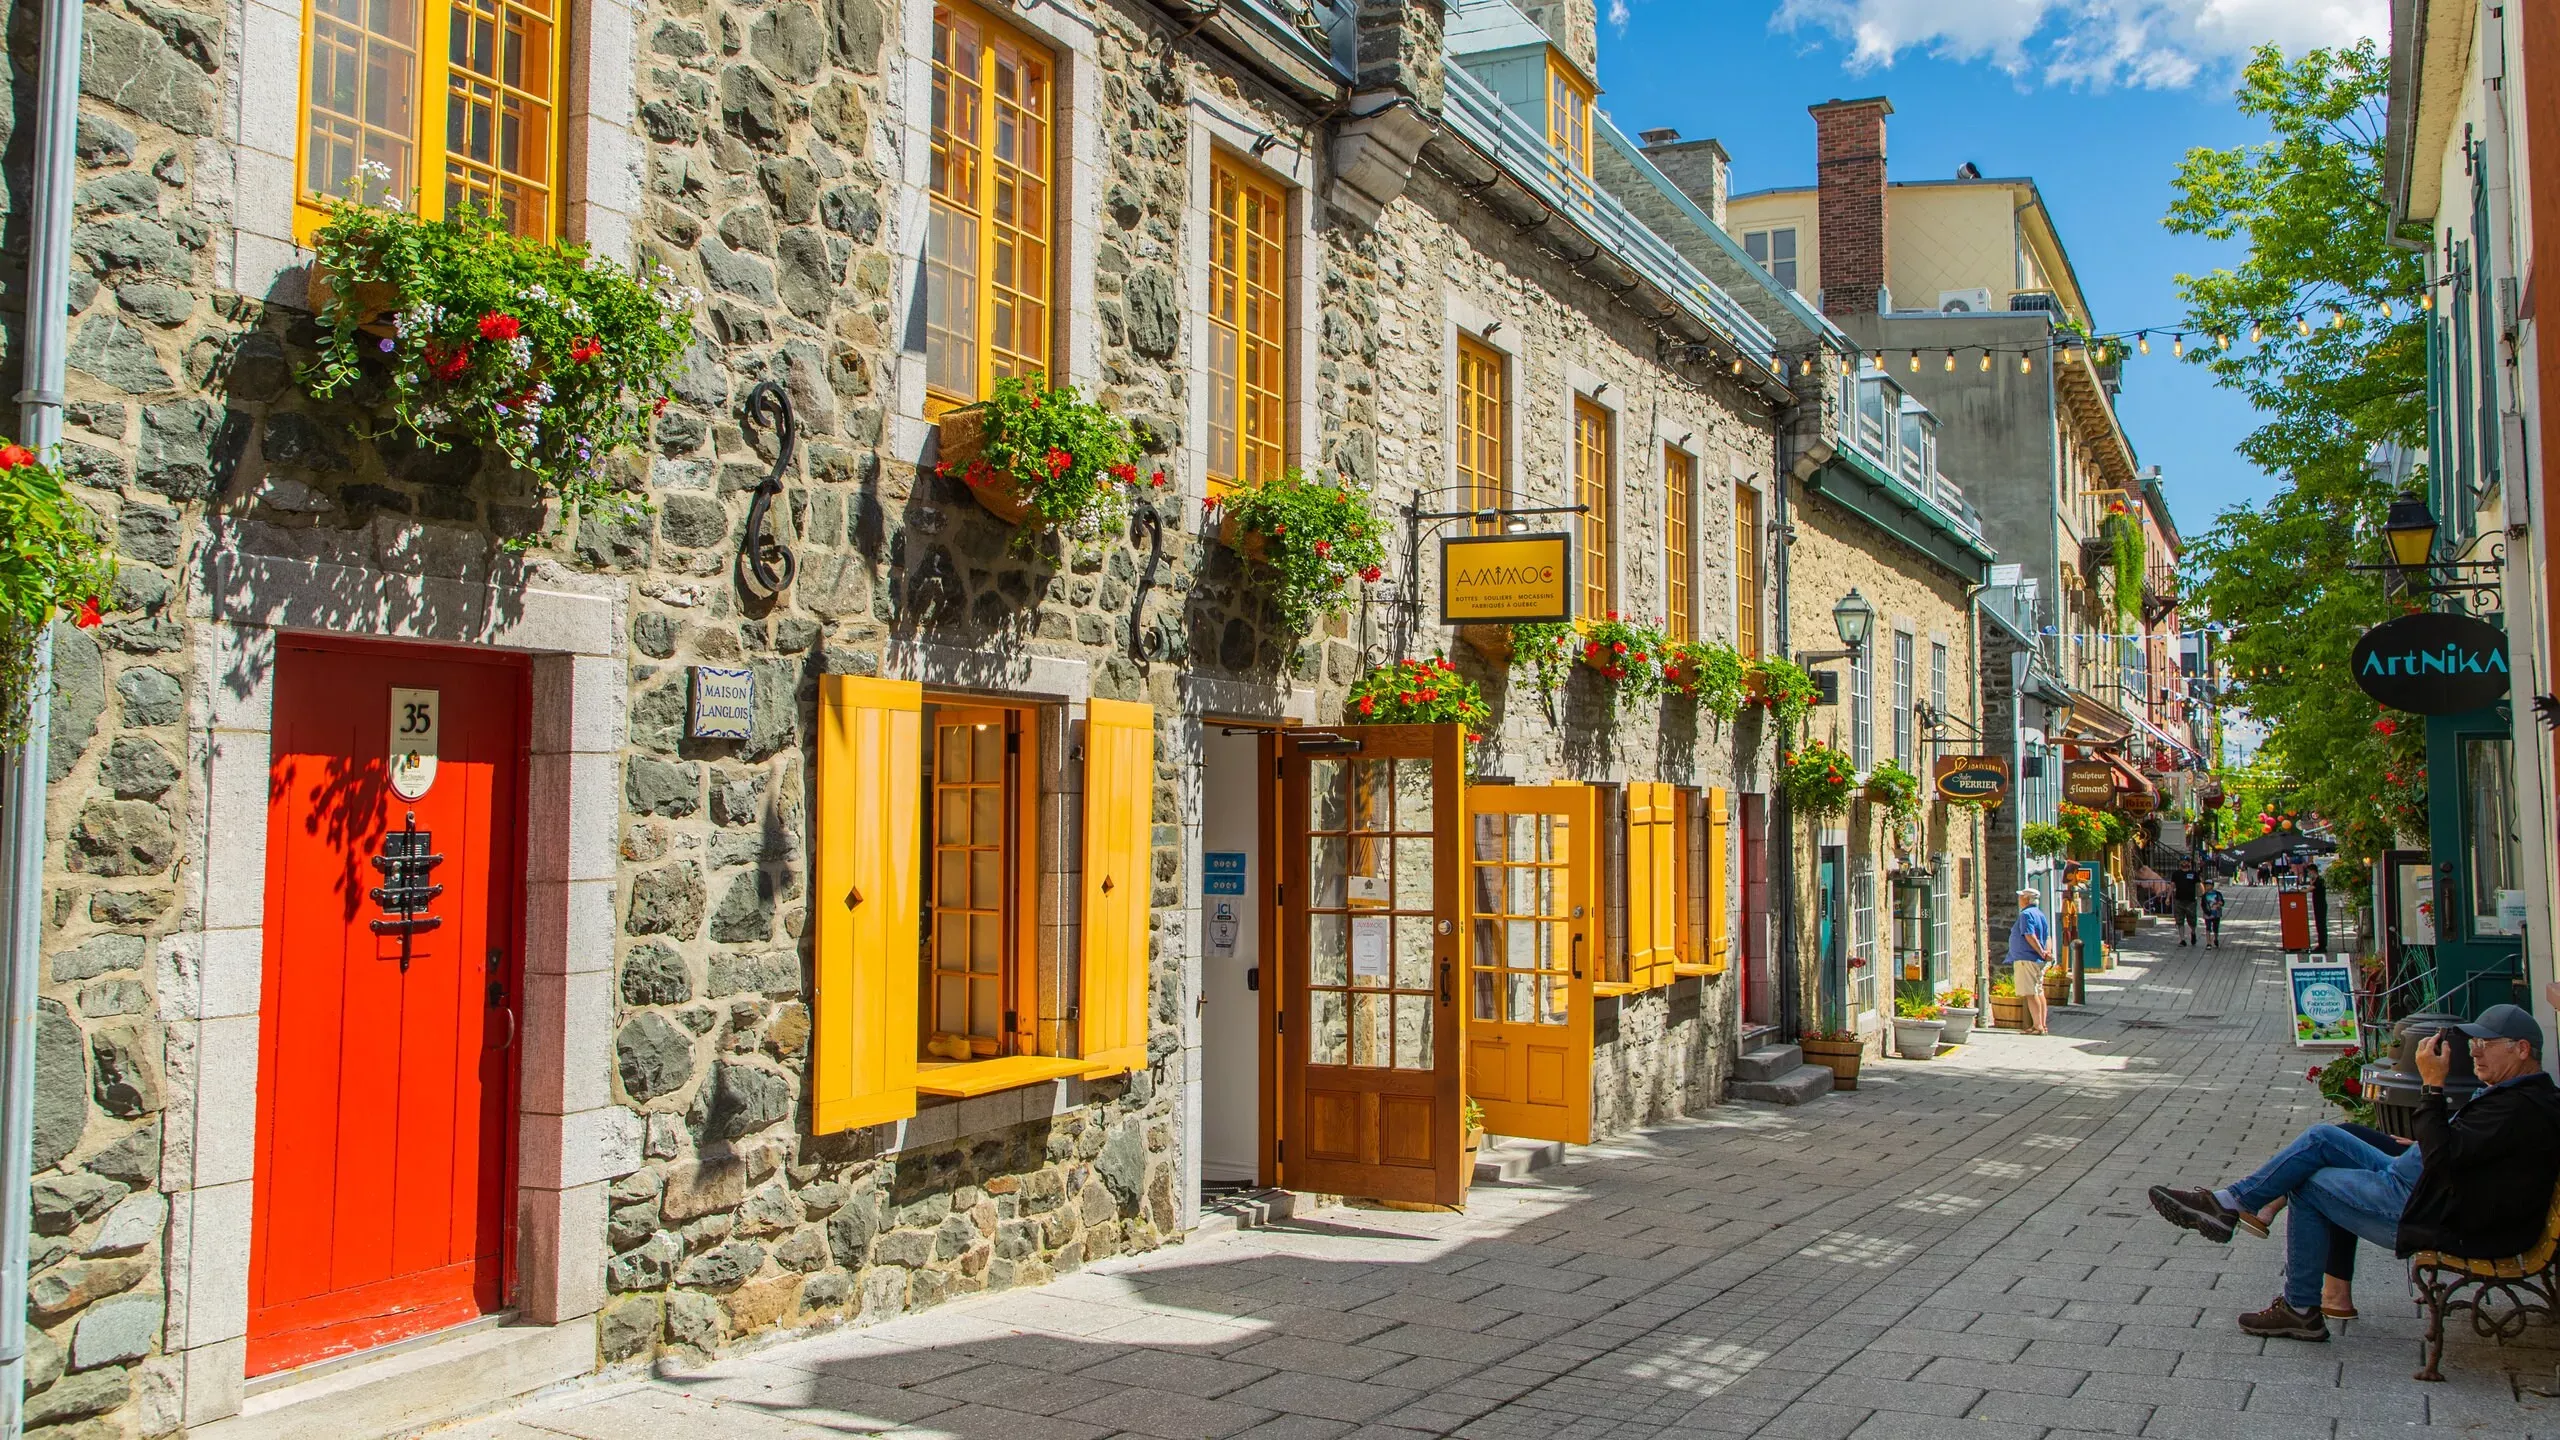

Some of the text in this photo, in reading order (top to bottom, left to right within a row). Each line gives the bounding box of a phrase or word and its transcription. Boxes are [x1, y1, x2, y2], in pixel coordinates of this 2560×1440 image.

[1456, 565, 1553, 586] AMIMOC
[1472, 601, 1505, 609] FABRIQUÉS
[705, 685, 747, 699] MAISON
[400, 703, 431, 734] 35
[701, 704, 749, 720] LANGLOIS
[2071, 771, 2106, 780] Sculpteur
[1959, 780, 1999, 793] PERRIER
[1217, 903, 1231, 914] ICI
